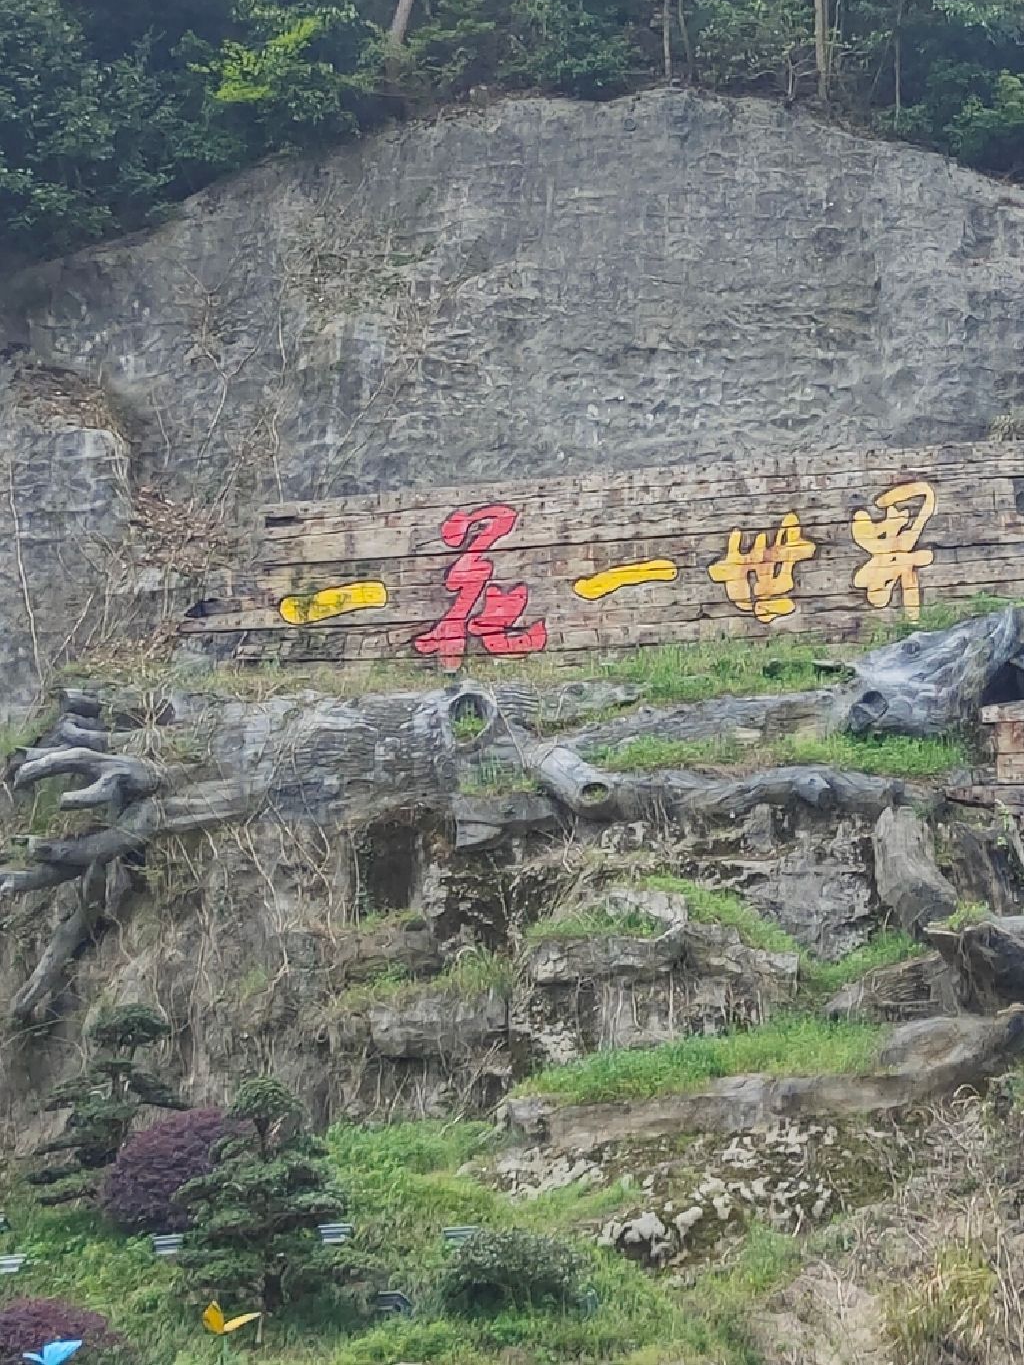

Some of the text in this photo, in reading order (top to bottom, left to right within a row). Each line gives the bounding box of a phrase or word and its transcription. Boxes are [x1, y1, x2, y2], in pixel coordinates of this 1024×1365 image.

[279, 482, 936, 668] 一花一世界
